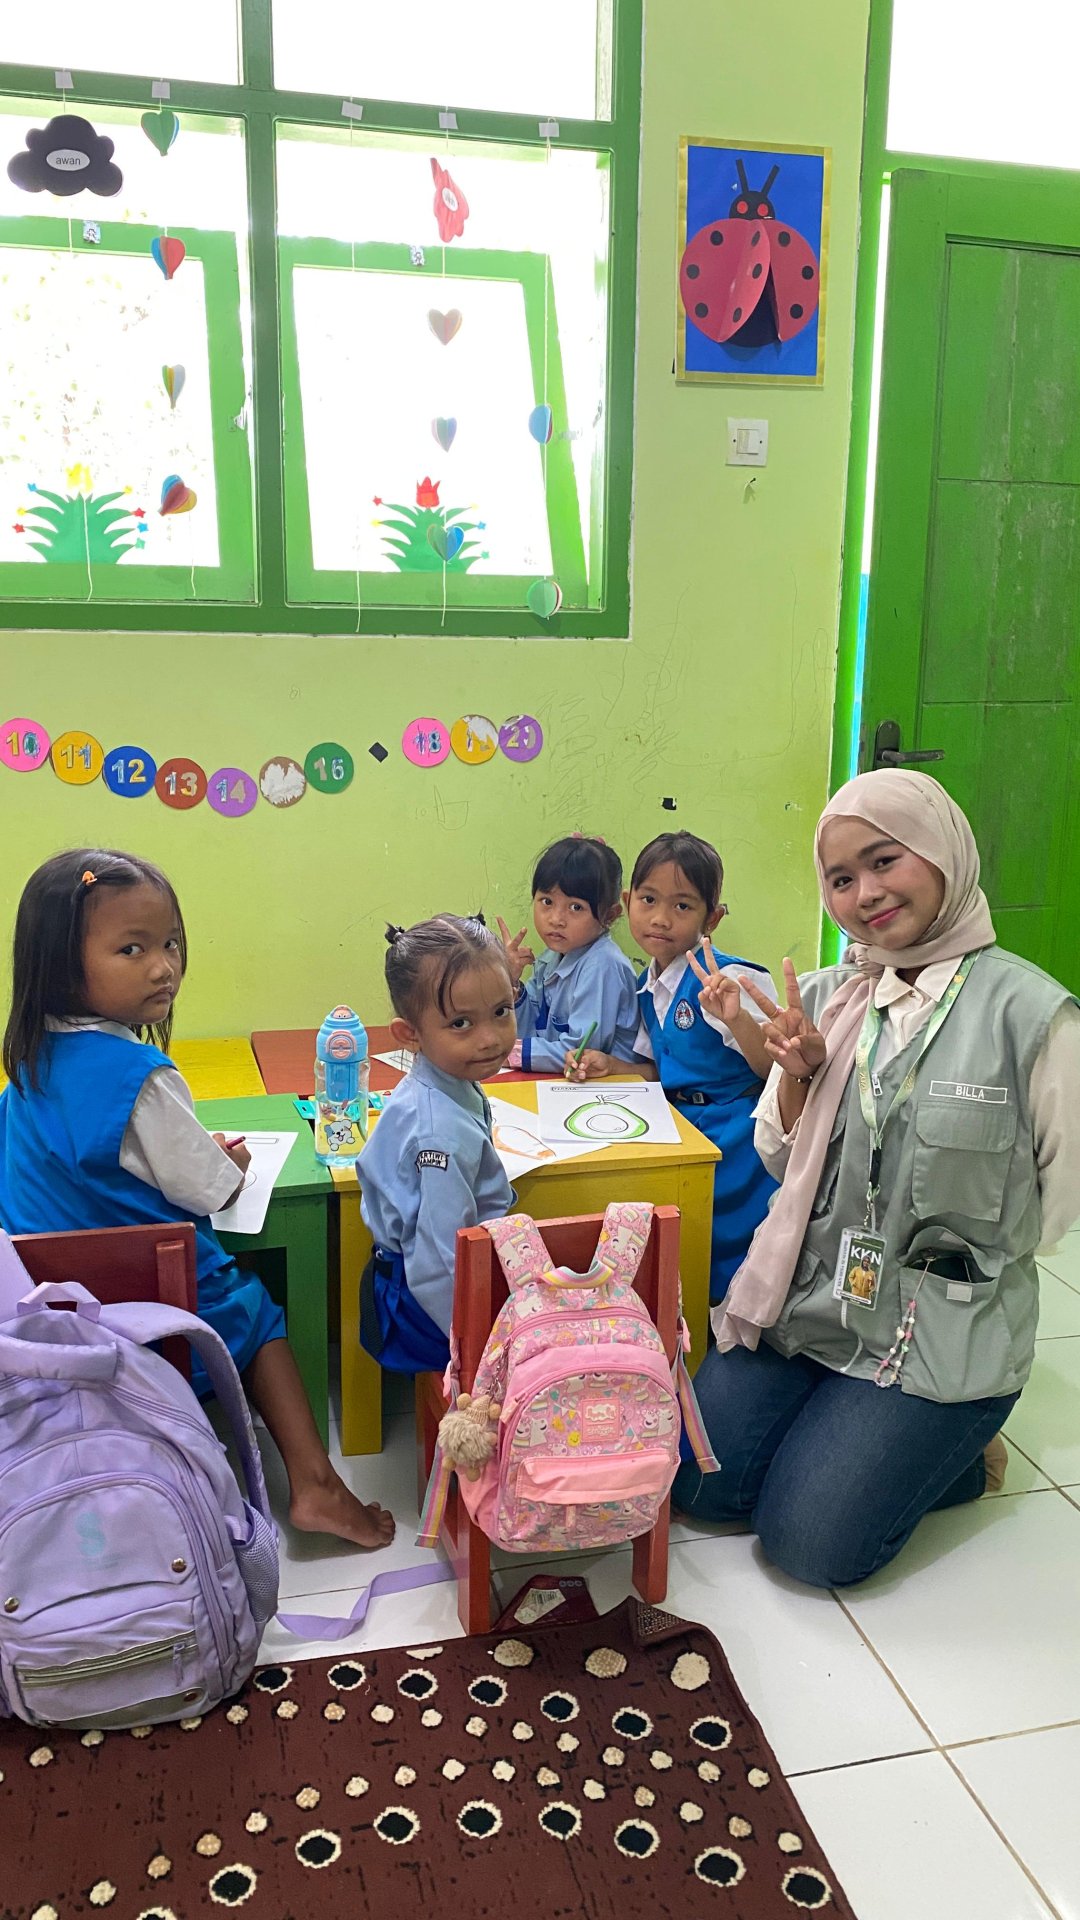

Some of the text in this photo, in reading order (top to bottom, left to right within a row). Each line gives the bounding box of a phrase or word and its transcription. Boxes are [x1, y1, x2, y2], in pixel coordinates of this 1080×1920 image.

[55, 157, 81, 166] awan
[6, 731, 41, 759] 10
[60, 743, 93, 770] 11
[111, 758, 147, 784] 12
[313, 756, 345, 781] 16
[164, 771, 198, 797] 13
[215, 778, 247, 804] 14
[955, 1085, 985, 1100] BILLA
[850, 1245, 883, 1266] KKN
